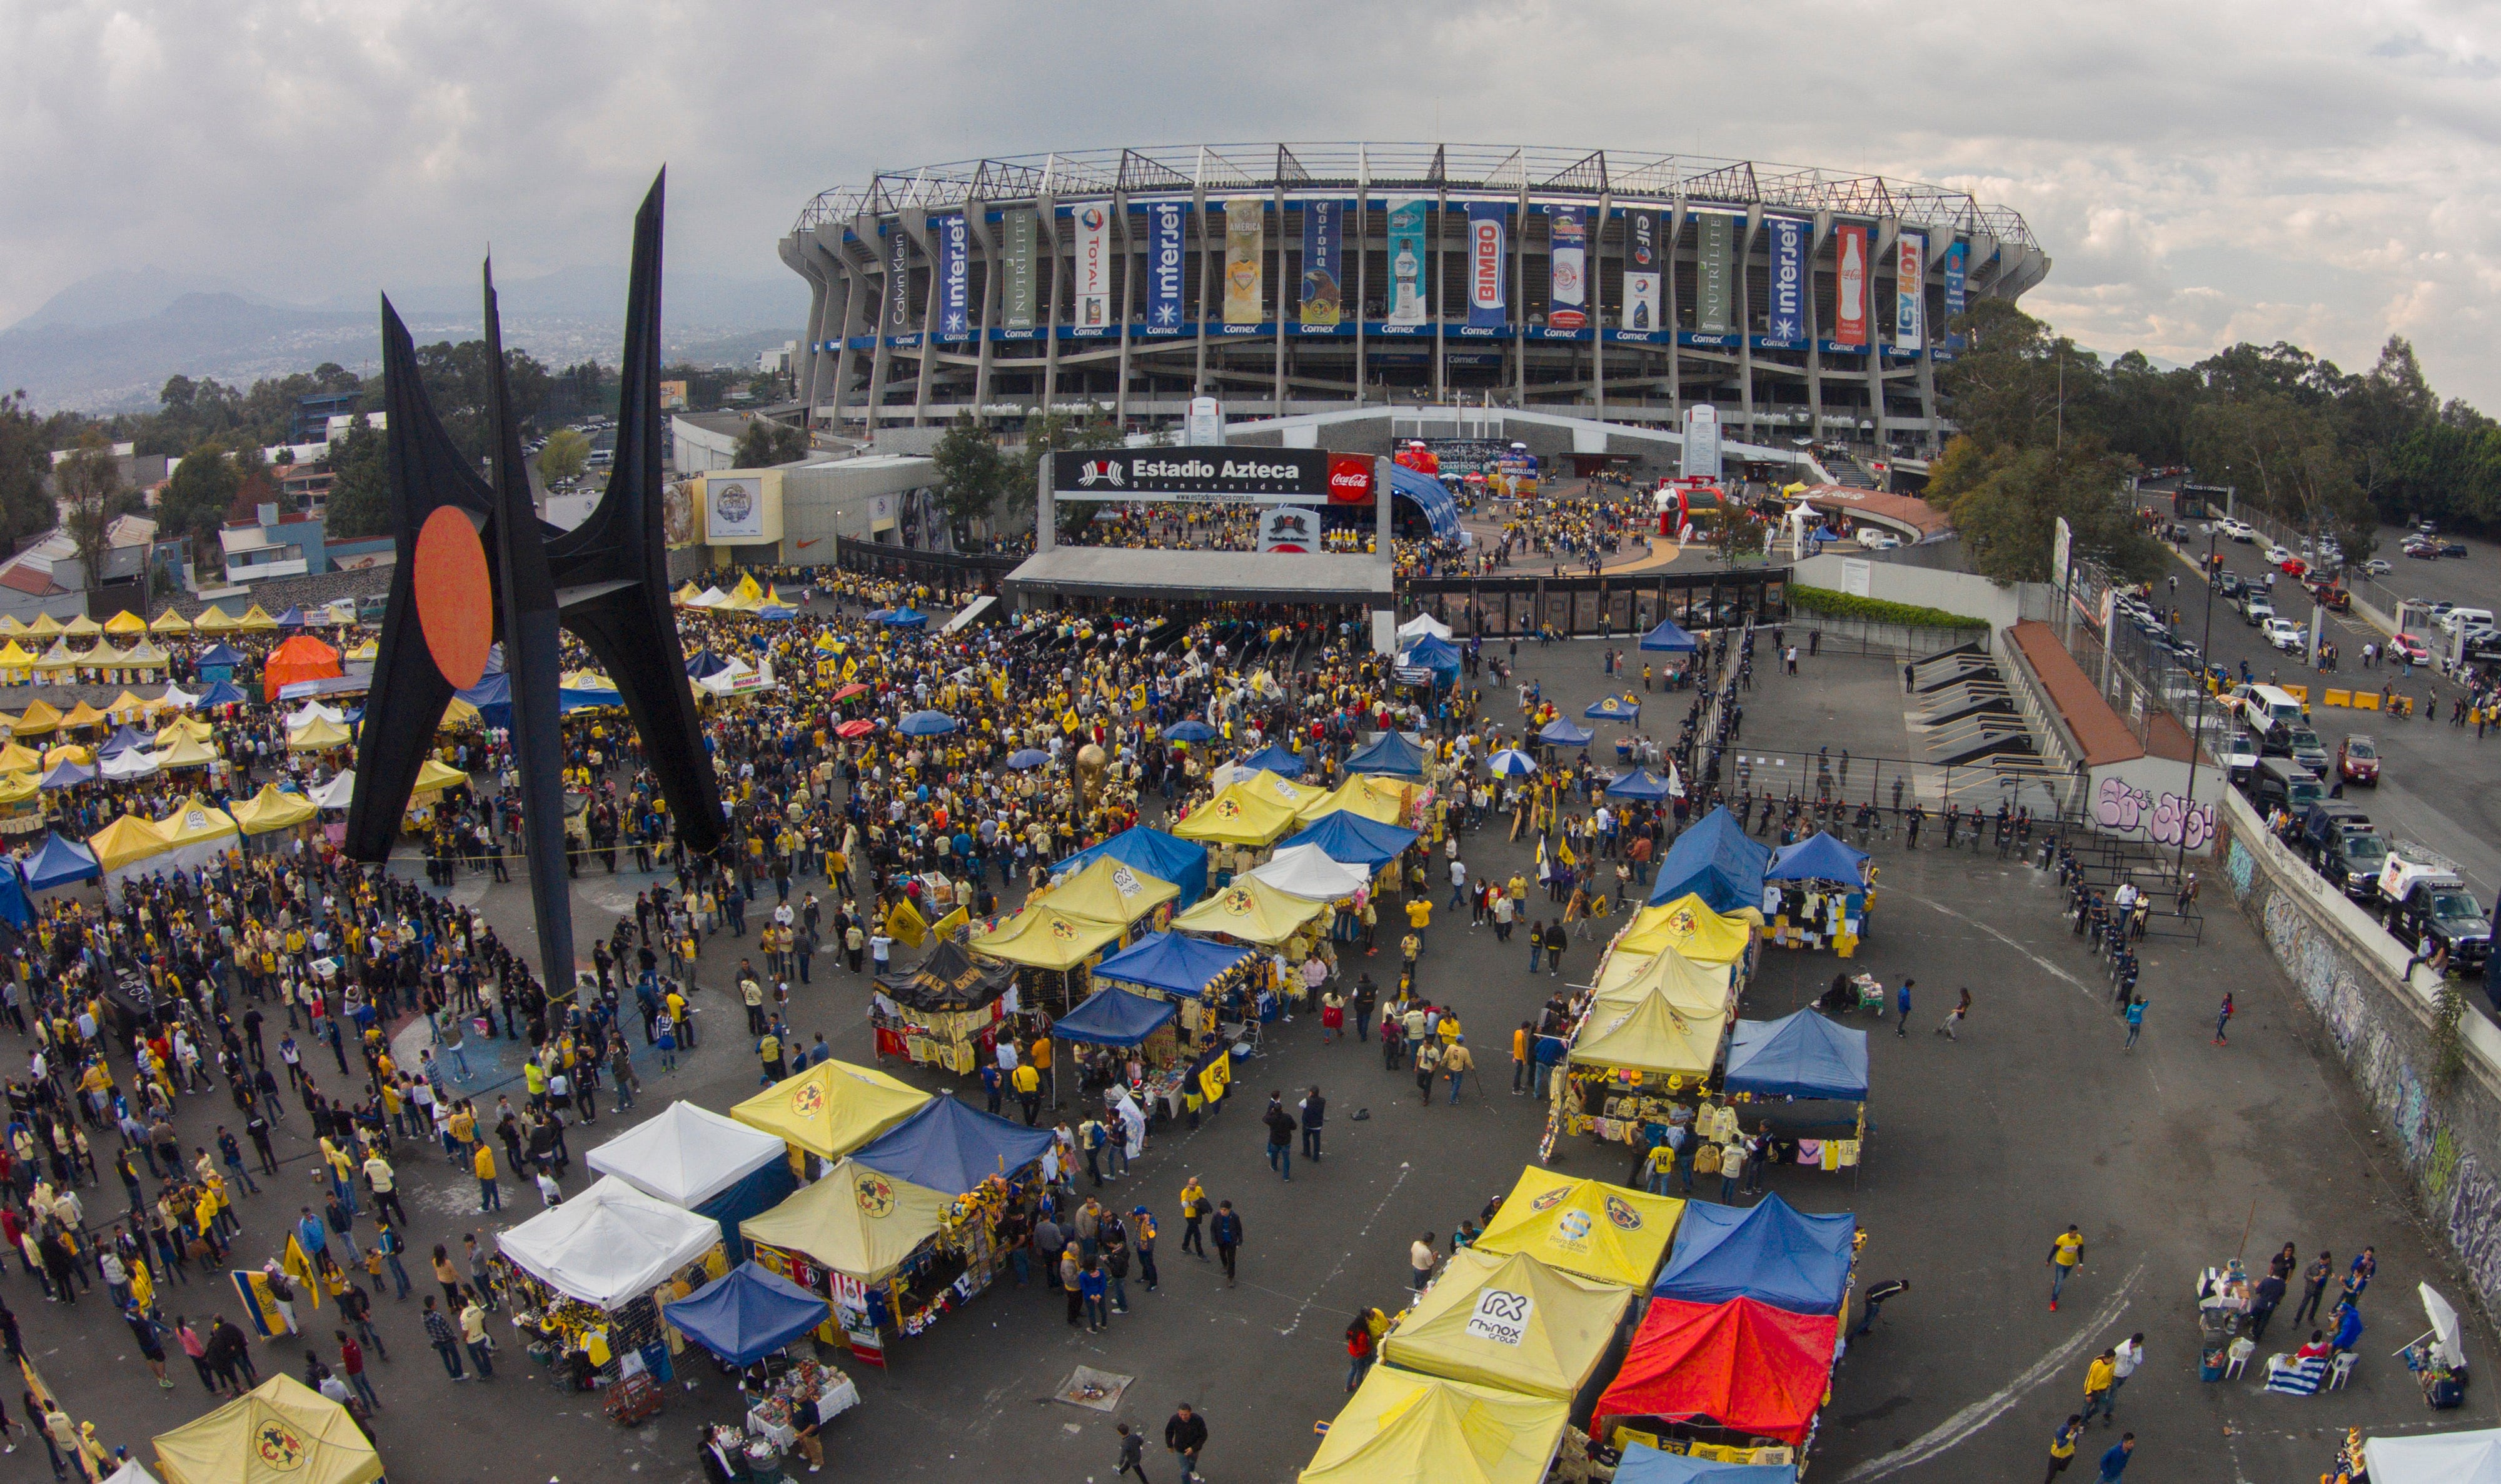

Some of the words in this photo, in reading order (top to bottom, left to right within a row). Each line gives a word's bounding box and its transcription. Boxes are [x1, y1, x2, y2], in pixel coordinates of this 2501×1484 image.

[1229, 221, 1261, 232] AMÉRICA
[1638, 216, 1650, 246] elf
[1316, 203, 1329, 267] Corona
[894, 234, 904, 273] Klein
[1015, 214, 1025, 311] NUTRILITE
[1089, 236, 1099, 291] TOTAL
[1478, 225, 1496, 301] BIMBO
[1710, 218, 1721, 316] NUTRILITE
[1898, 241, 1918, 294] HOT
[893, 275, 905, 325] Calvin
[1898, 294, 1914, 336] ICY
[1005, 329, 1034, 338] Comex
[1073, 327, 1104, 336] Comex
[1147, 326, 1181, 335] Comex
[1224, 324, 1259, 334] Comex
[1301, 324, 1337, 334] Comex
[1382, 324, 1417, 334] Comex
[1461, 326, 1496, 336] Comex
[1544, 328, 1579, 338] Comex
[896, 335, 916, 344] Comex
[944, 333, 970, 341] Comex
[1617, 331, 1650, 341] Comex
[1692, 333, 1723, 344] Comex
[1761, 338, 1792, 348] Comex
[1829, 342, 1856, 351] Comex
[1888, 346, 1911, 356] Comex
[1934, 350, 1951, 359] Comex
[1449, 356, 1481, 364] Comex
[1133, 459, 1215, 478] Estadio
[1220, 461, 1299, 479] Azteca
[1133, 481, 1300, 491] Bienvenidos
[1227, 895, 1237, 905] C
[1242, 898, 1252, 908] A
[1669, 916, 1680, 927] C
[1686, 919, 1694, 930] A
[796, 1090, 808, 1102] C
[810, 1096, 821, 1109] A
[1658, 1156, 1668, 1167] 14
[860, 1193, 873, 1209] C
[877, 1183, 891, 1198] A
[1549, 1235, 1588, 1250] PromoShow
[1469, 1318, 1521, 1339] rhinox
[262, 1442, 279, 1460] C
[285, 1434, 301, 1451] A
